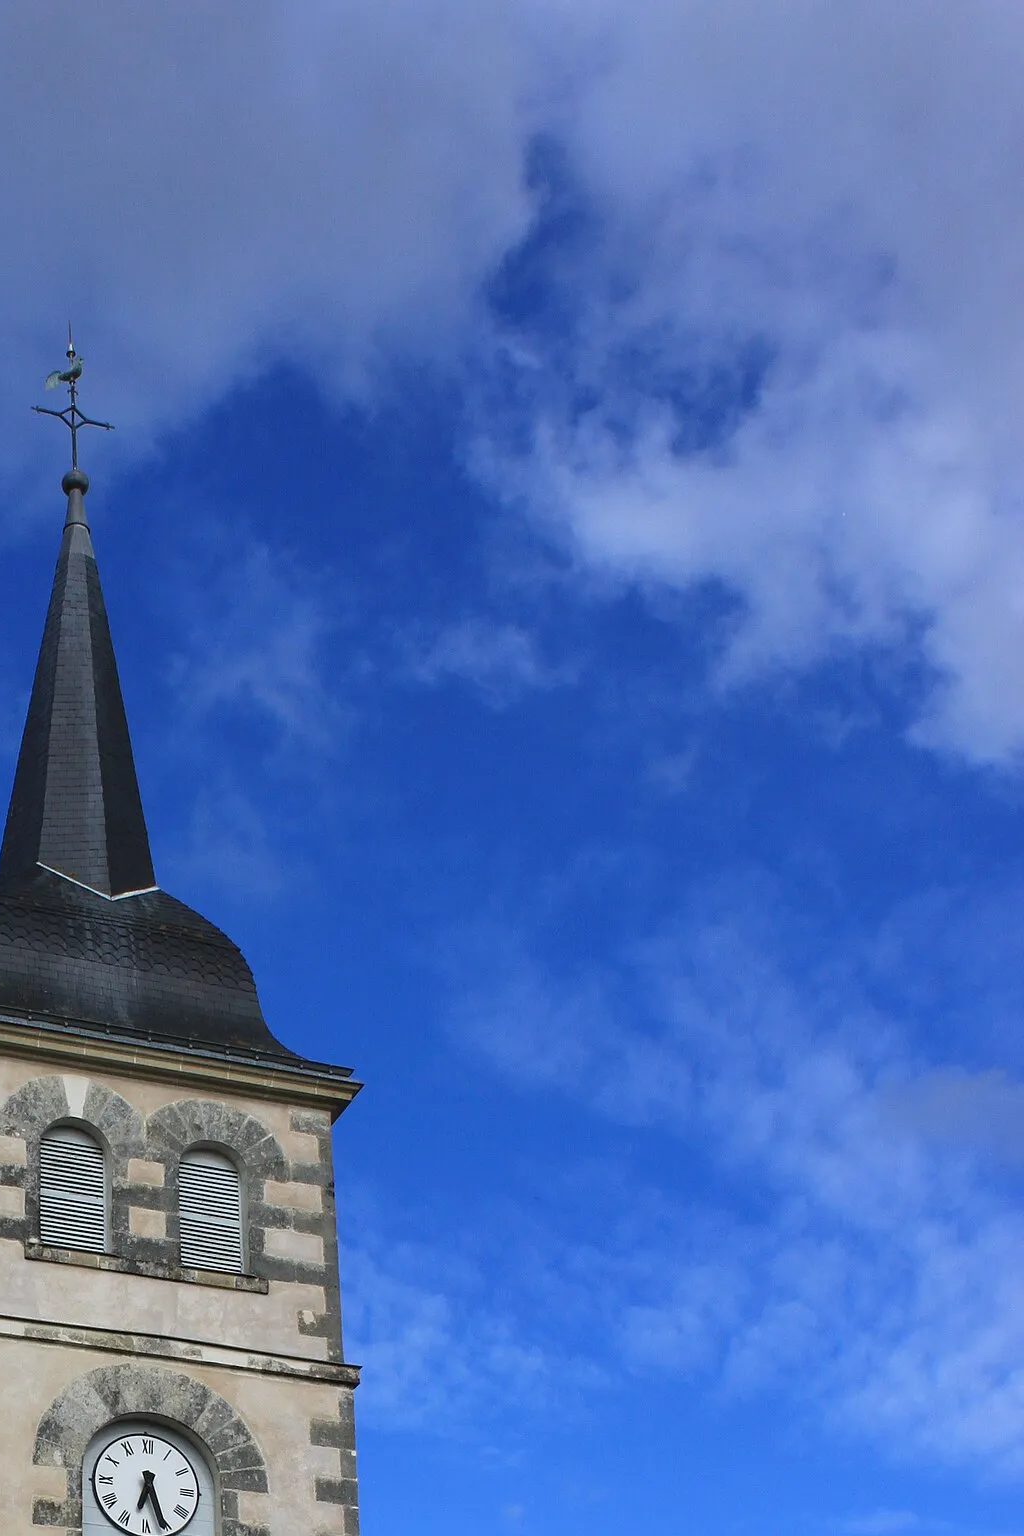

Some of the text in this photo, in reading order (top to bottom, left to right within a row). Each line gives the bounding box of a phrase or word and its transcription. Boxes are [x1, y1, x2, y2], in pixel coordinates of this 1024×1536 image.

[121, 1441, 134, 1456] XI
[142, 1439, 154, 1455] XII
[105, 1455, 120, 1467] X
[163, 1449, 172, 1461] I
[99, 1474, 114, 1485] IX
[175, 1468, 189, 1477] II
[180, 1488, 194, 1498] III
[102, 1492, 118, 1509] VIII
[118, 1510, 131, 1527] VII
[173, 1504, 190, 1520] IIII
[142, 1519, 151, 1533] VI
